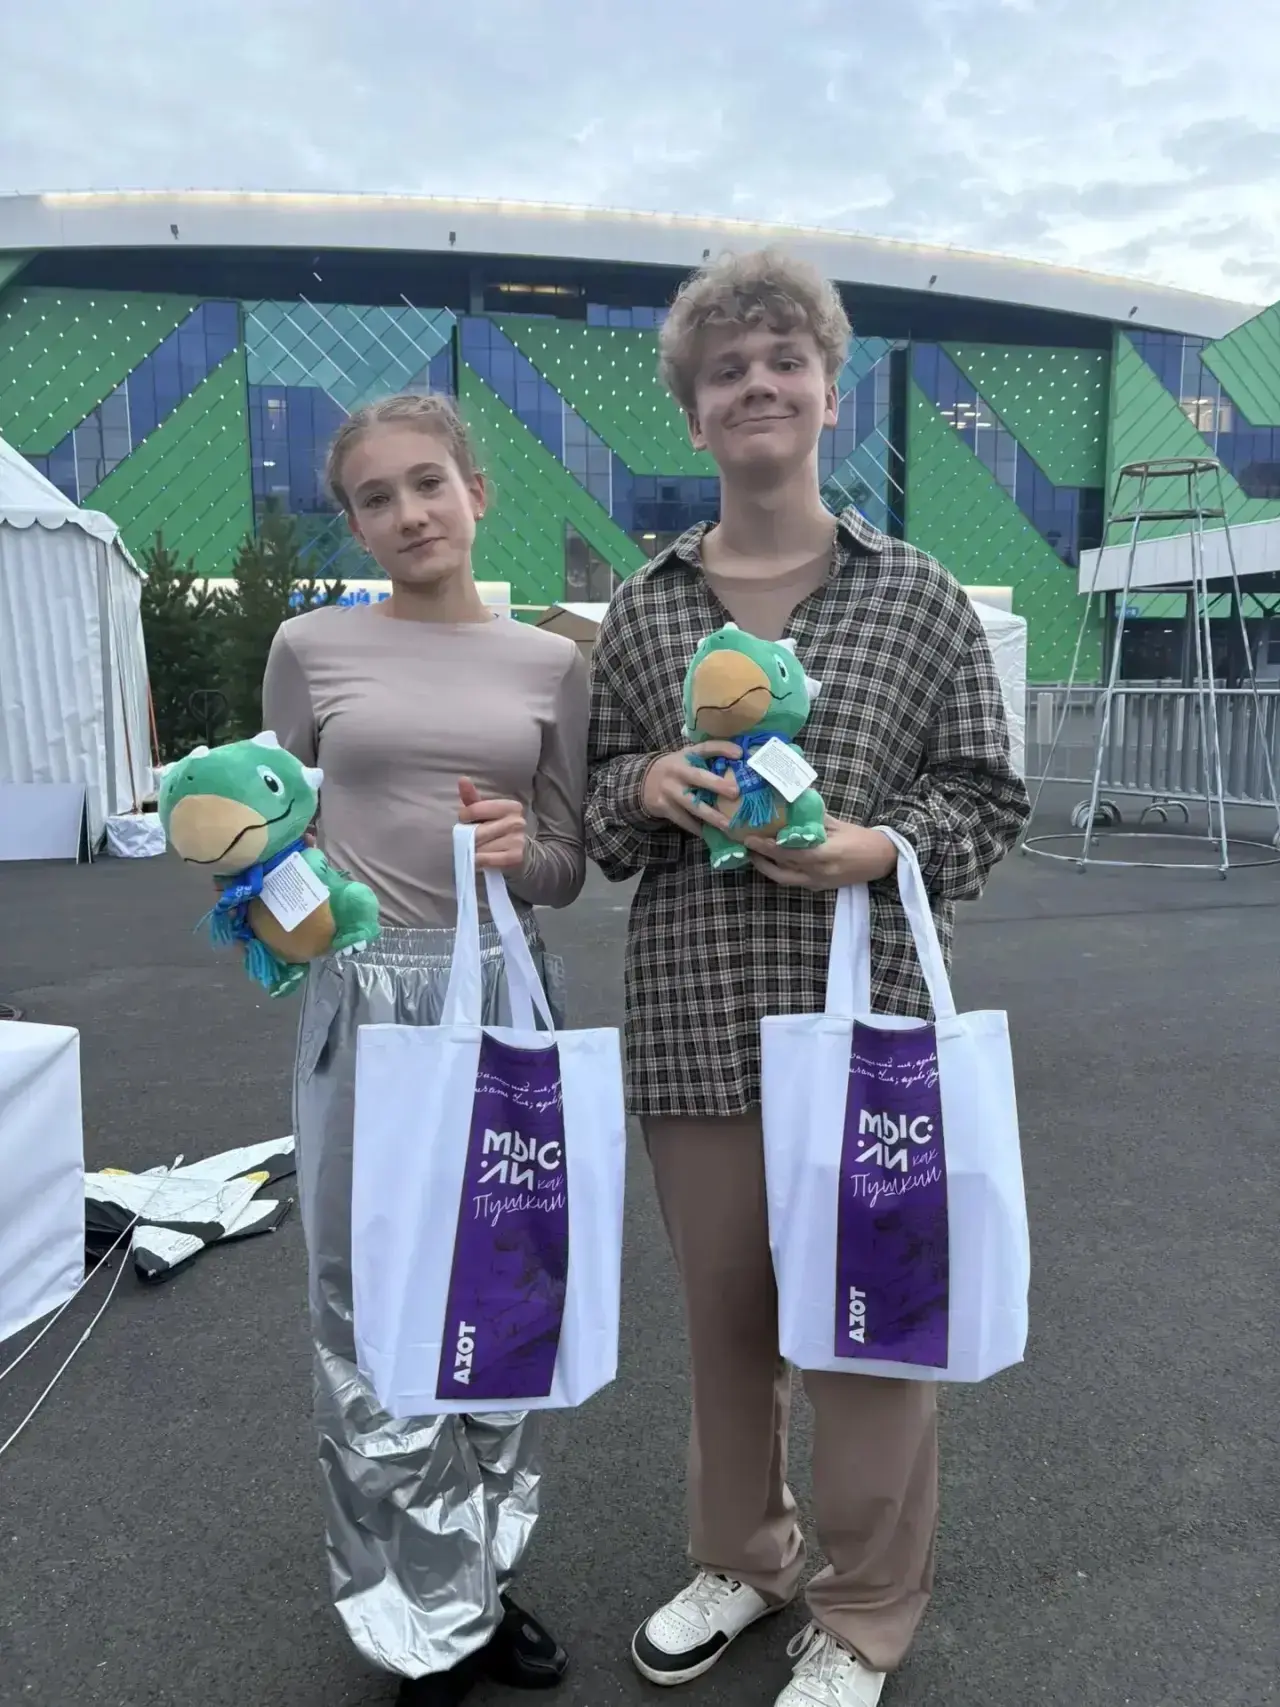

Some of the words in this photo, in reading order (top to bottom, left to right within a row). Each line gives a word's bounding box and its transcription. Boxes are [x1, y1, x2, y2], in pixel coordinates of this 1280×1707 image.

[911, 1147, 939, 1168] как
[850, 1165, 942, 1208] Пушкин
[472, 1191, 566, 1227] Пушкин
[848, 1285, 866, 1344] АЗОТ
[452, 1320, 476, 1385] АЗОТ
